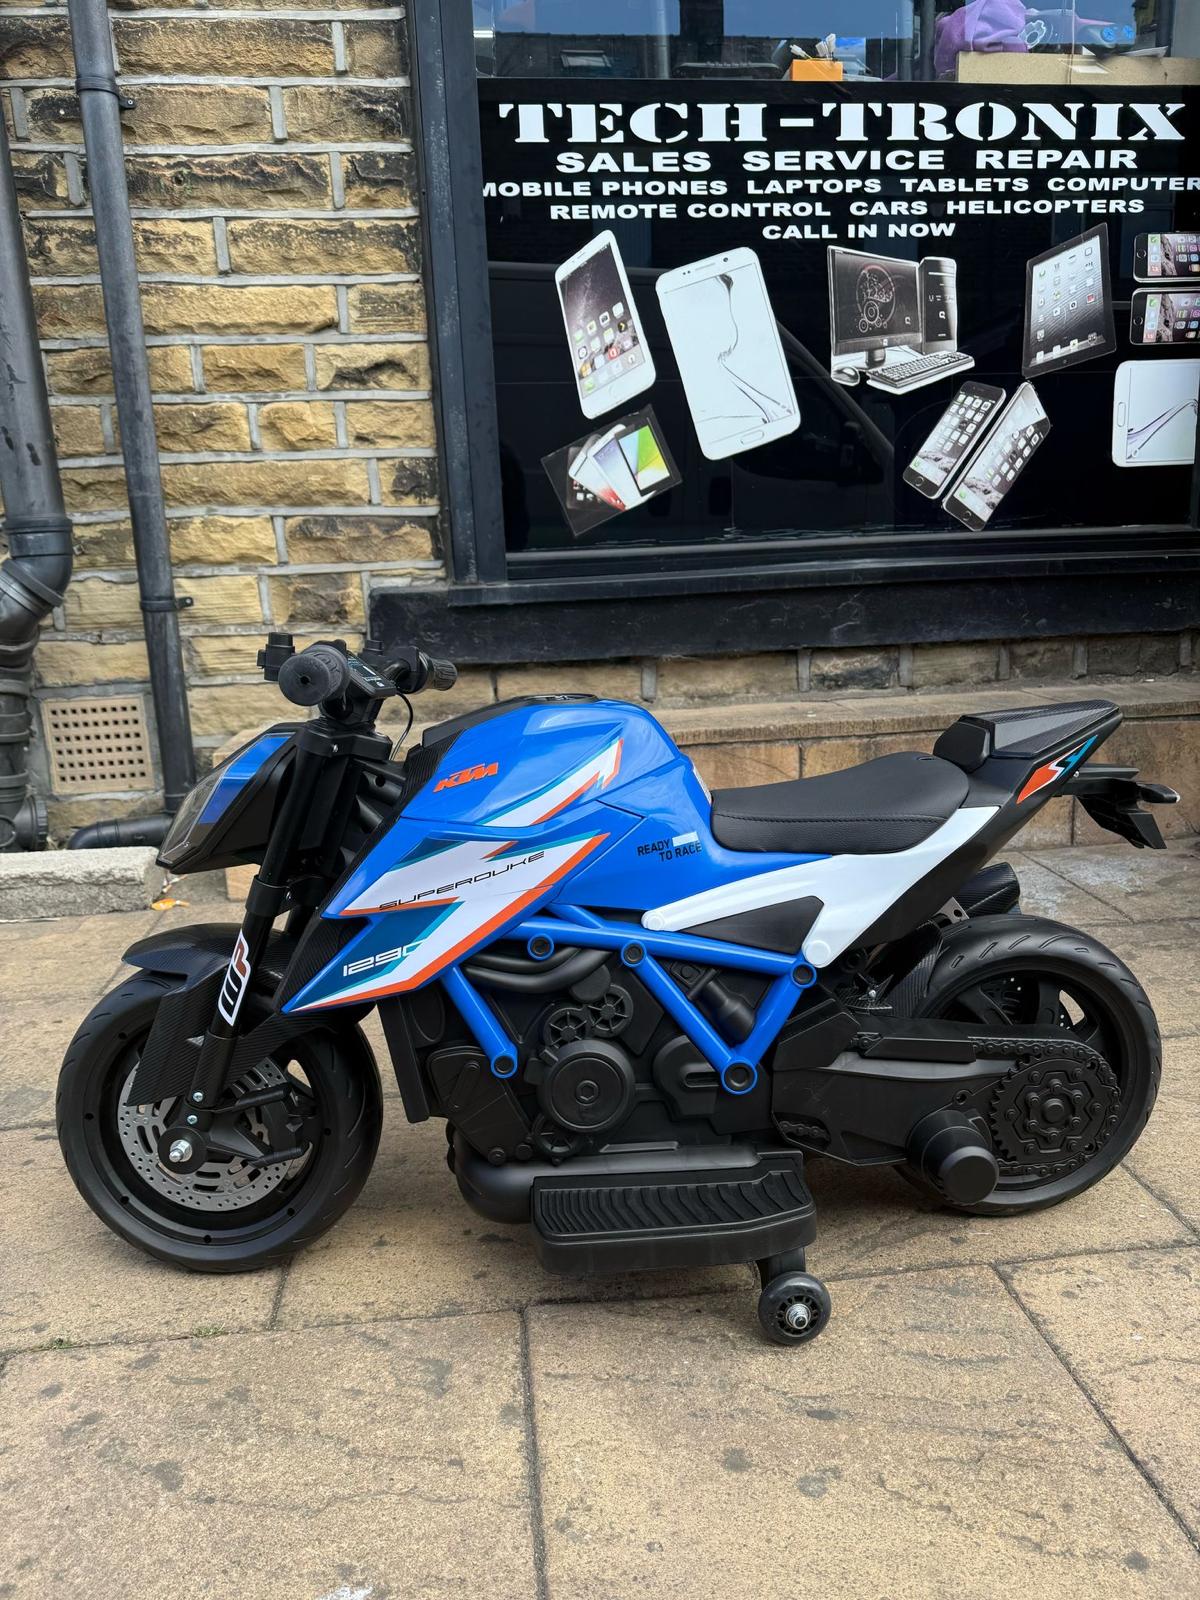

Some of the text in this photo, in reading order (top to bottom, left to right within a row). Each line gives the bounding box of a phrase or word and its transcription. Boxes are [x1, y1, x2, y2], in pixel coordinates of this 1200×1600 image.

[499, 102, 1186, 143] TECH-TRONIX
[556, 149, 1138, 174] SALES SERVICE REPAIR
[483, 176, 1200, 198] MOBILE PHONES LAPTOPS TABLETS COMPUTER
[550, 199, 1145, 220] REMOTE CONTROL CARS HELICOPTERS
[762, 222, 956, 240] CALL IN NOW
[433, 762, 498, 792] KTM
[637, 838, 670, 857] READY
[659, 841, 702, 861] TO RACE
